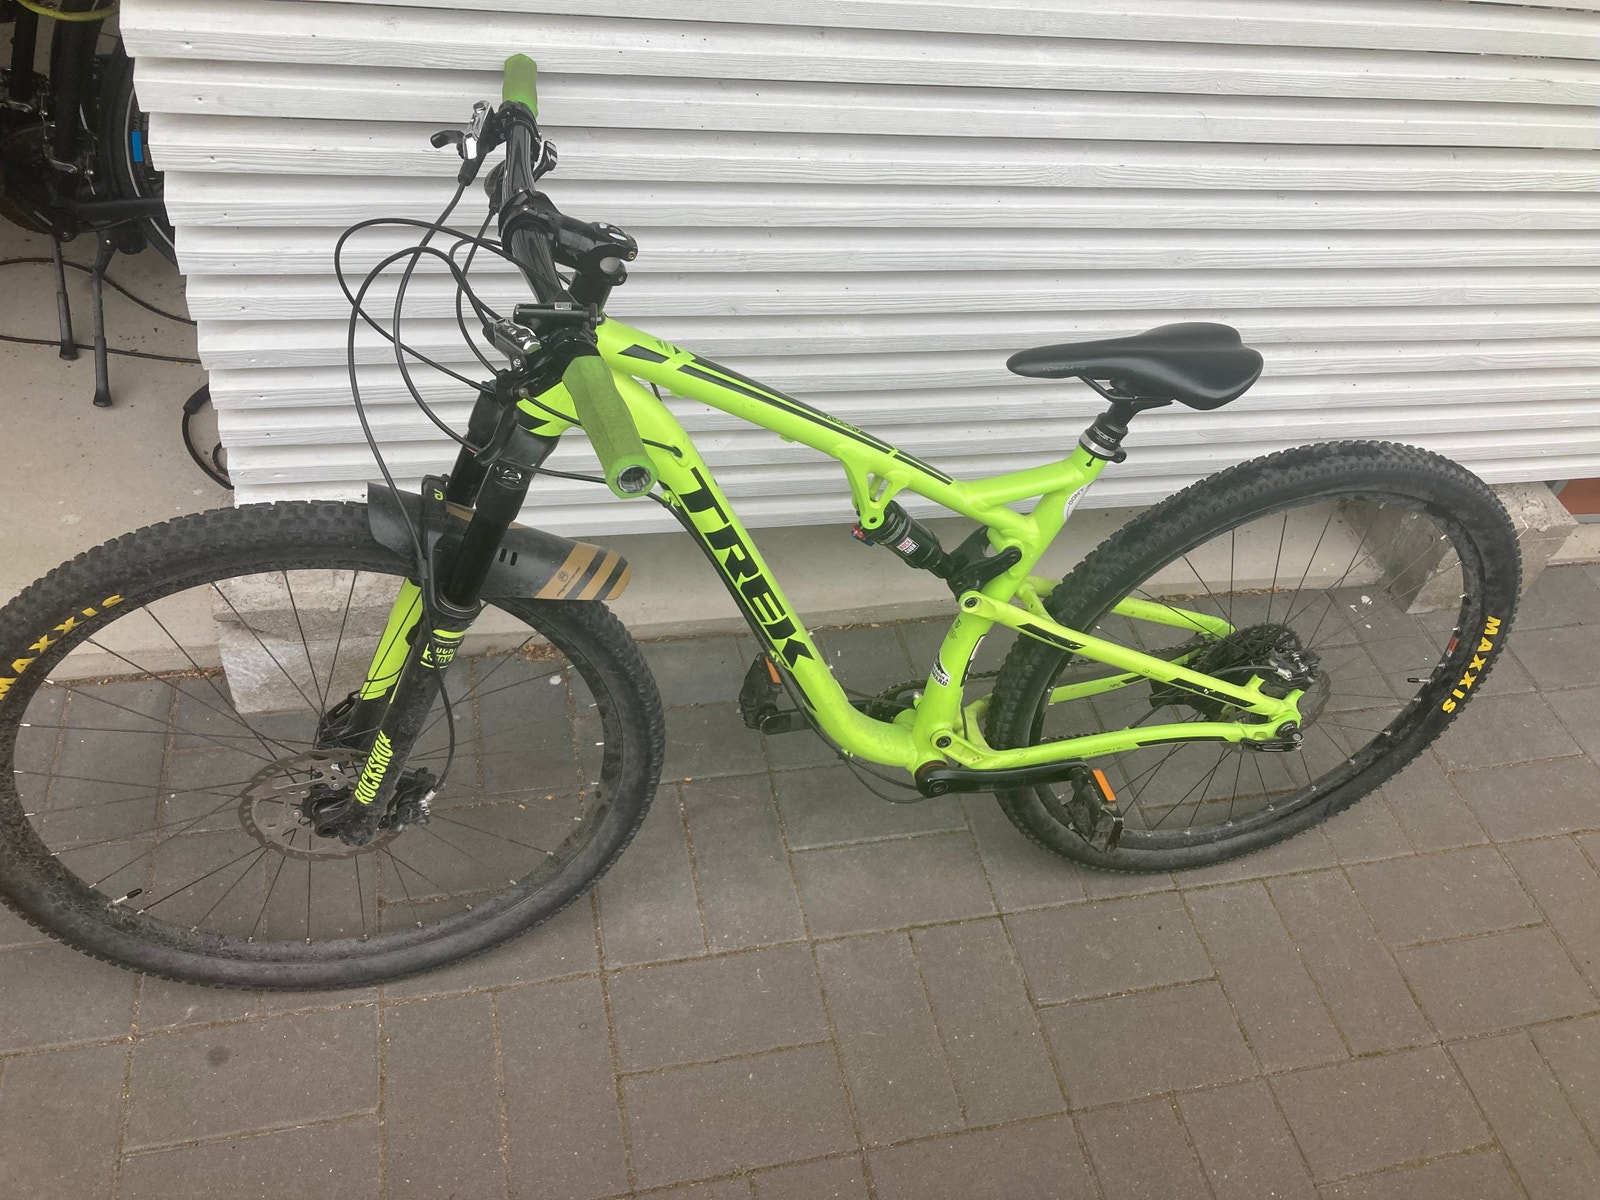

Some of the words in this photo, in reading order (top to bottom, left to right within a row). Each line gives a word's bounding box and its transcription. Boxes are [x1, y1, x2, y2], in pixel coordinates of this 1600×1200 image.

[679, 467, 814, 668] TREK
[0, 594, 125, 700] MAXXIS
[1442, 616, 1501, 714] MAXXIS
[354, 730, 394, 805] ROCKSHOX
